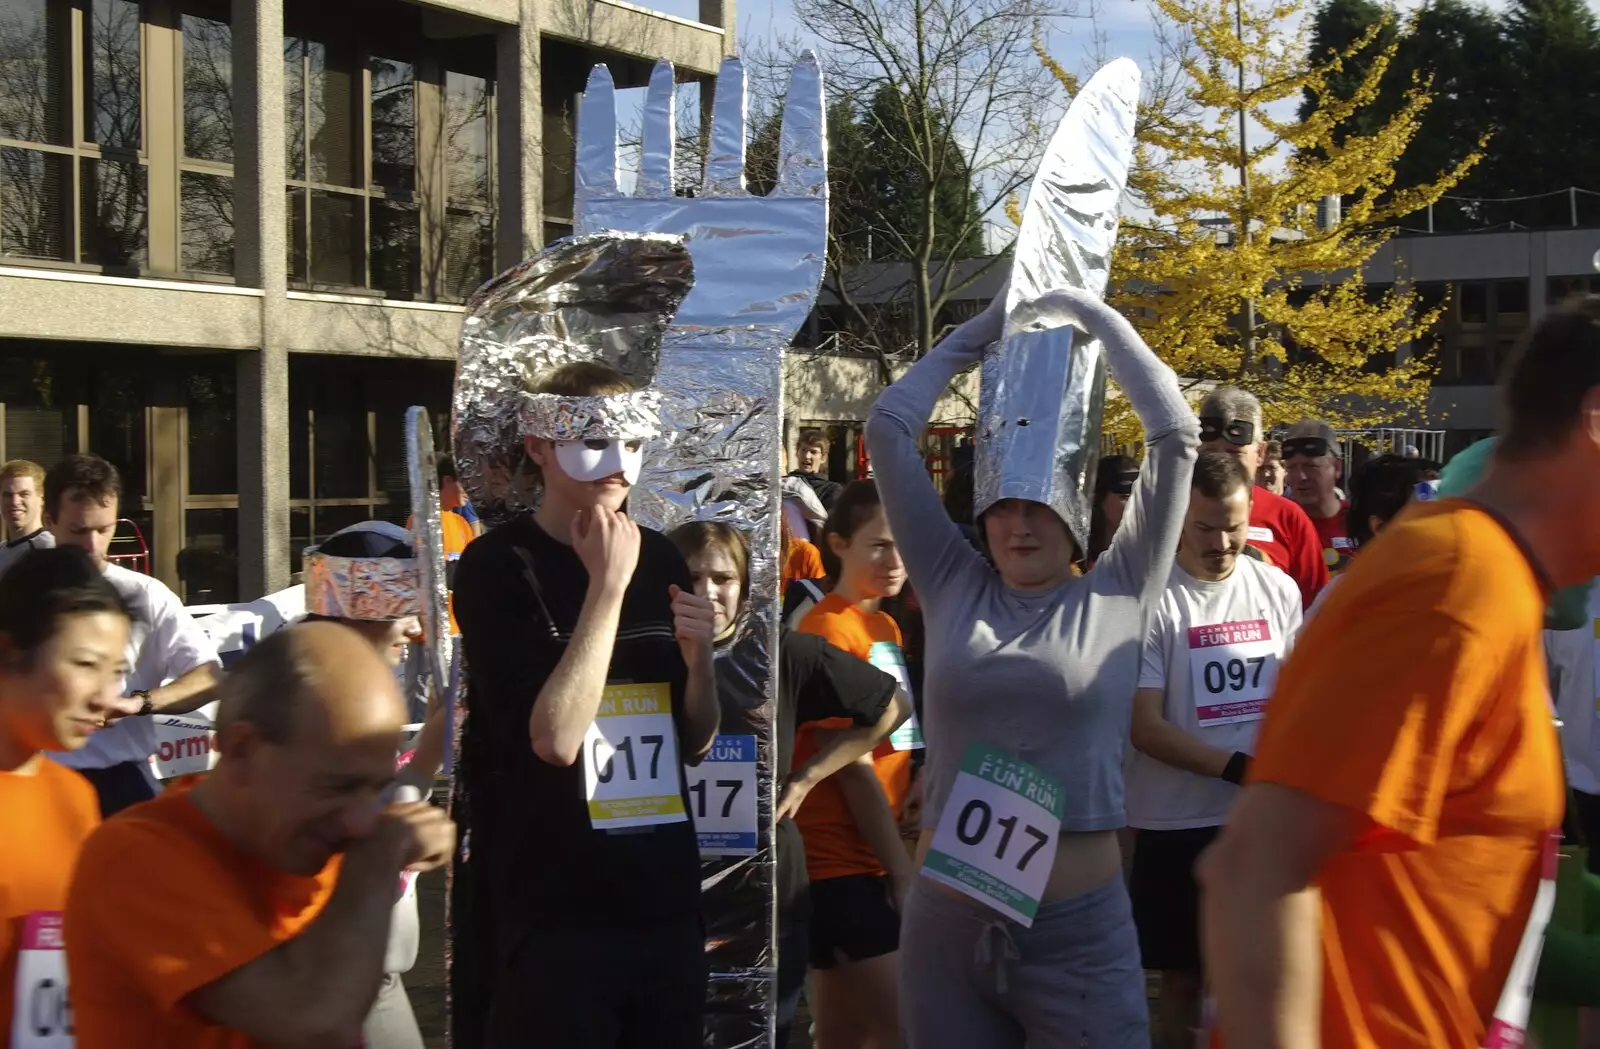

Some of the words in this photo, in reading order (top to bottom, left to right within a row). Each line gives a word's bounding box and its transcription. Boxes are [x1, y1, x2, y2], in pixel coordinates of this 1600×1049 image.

[1199, 623, 1260, 635] CAMBRIDGE
[1200, 633, 1230, 646] FUN
[1233, 628, 1262, 643] RUN
[1204, 656, 1265, 694] 097
[622, 696, 658, 713] RUN
[593, 735, 664, 784] 017
[690, 779, 743, 818] 17
[978, 760, 1024, 791] FUN
[1025, 781, 1057, 812] RUN
[956, 799, 1049, 872] 017
